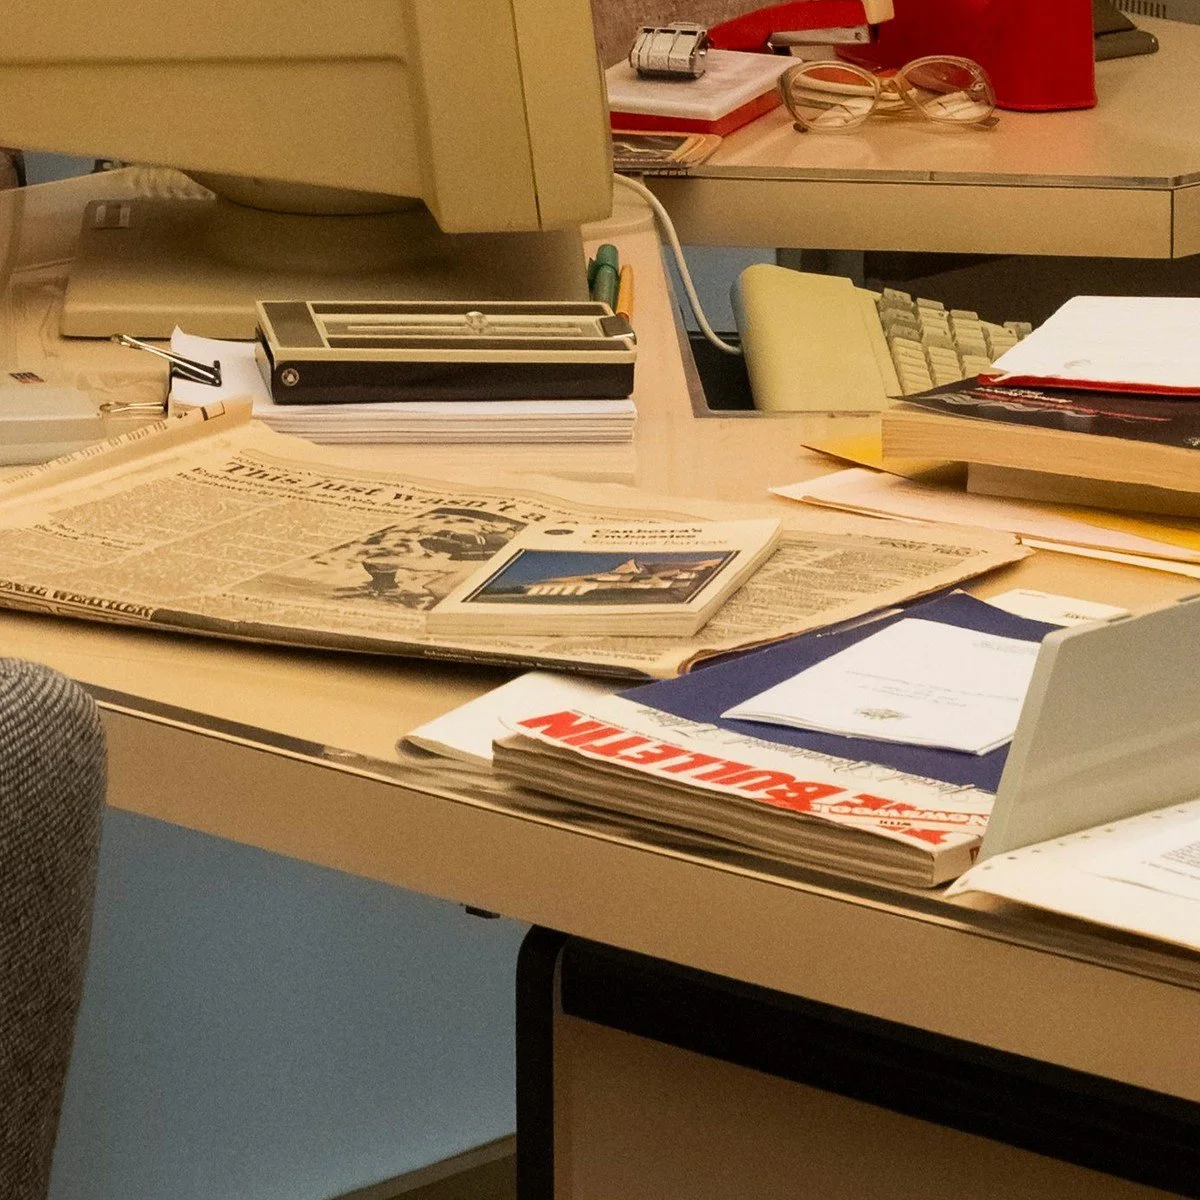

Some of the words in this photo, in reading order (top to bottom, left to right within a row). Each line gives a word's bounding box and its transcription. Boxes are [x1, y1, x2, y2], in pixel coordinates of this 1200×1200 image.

[223, 462, 303, 484] This
[307, 477, 386, 497] just
[517, 709, 850, 815] BULLETIN
